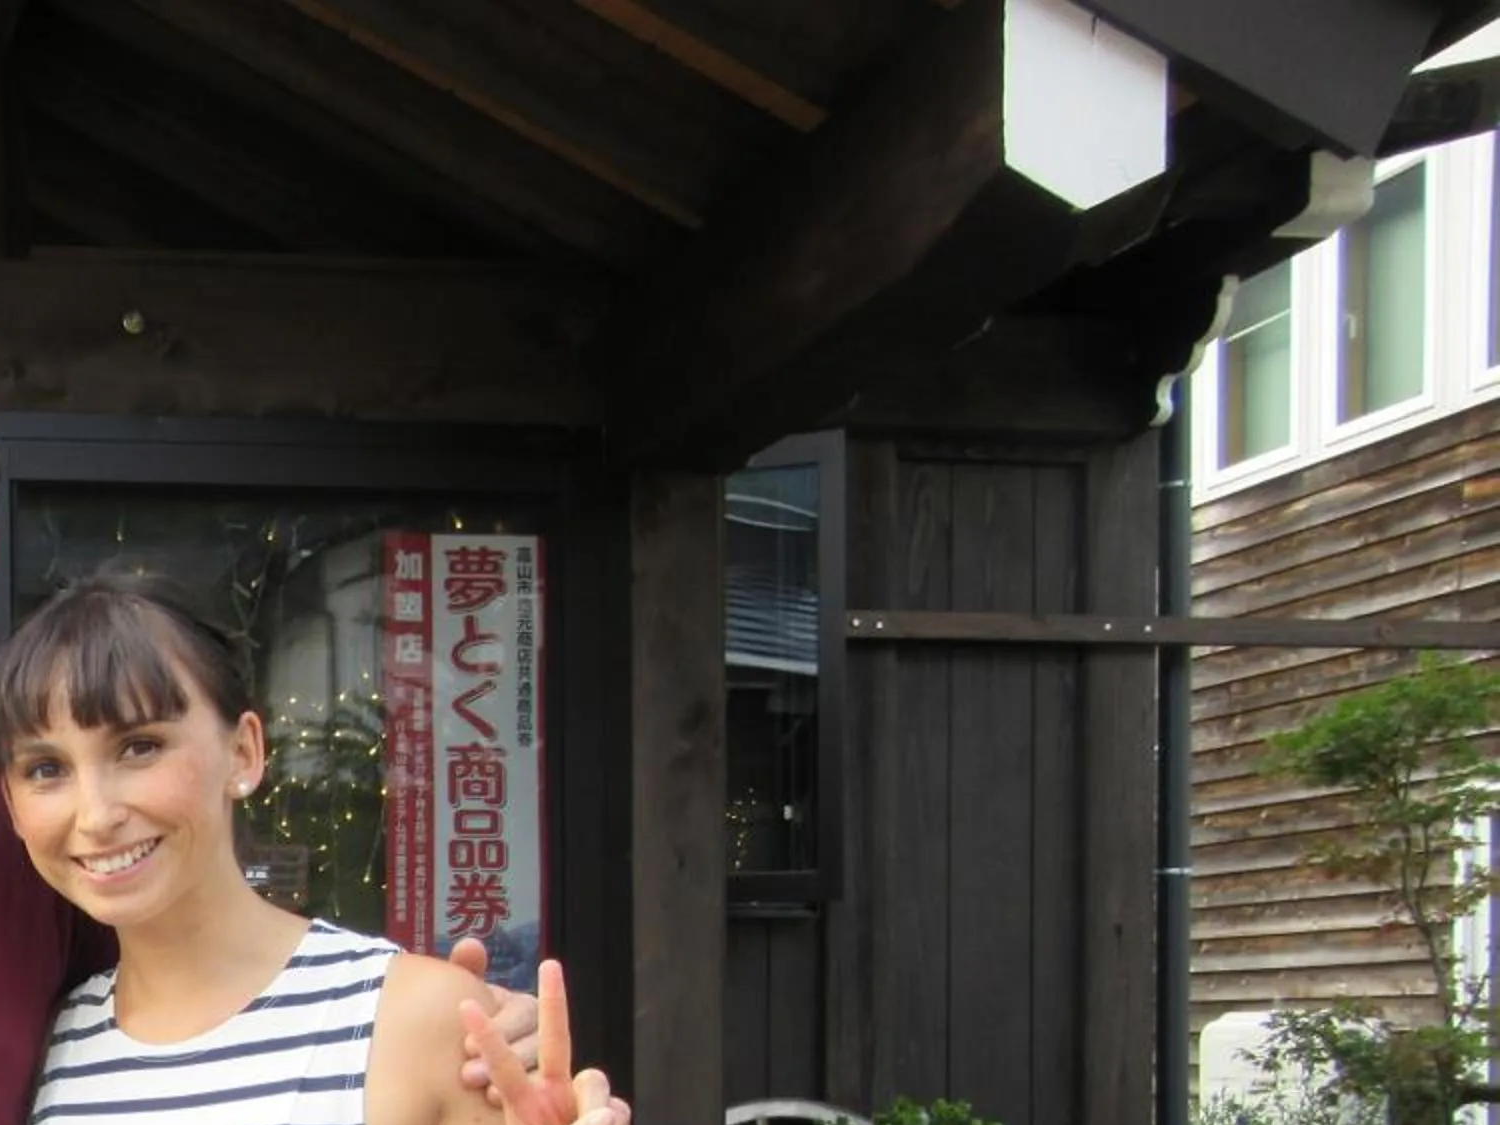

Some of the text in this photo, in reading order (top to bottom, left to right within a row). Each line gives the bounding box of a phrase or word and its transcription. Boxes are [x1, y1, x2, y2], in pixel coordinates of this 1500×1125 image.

[395, 551, 425, 664] 加盟店
[444, 546, 509, 938] 夢とく商品券
